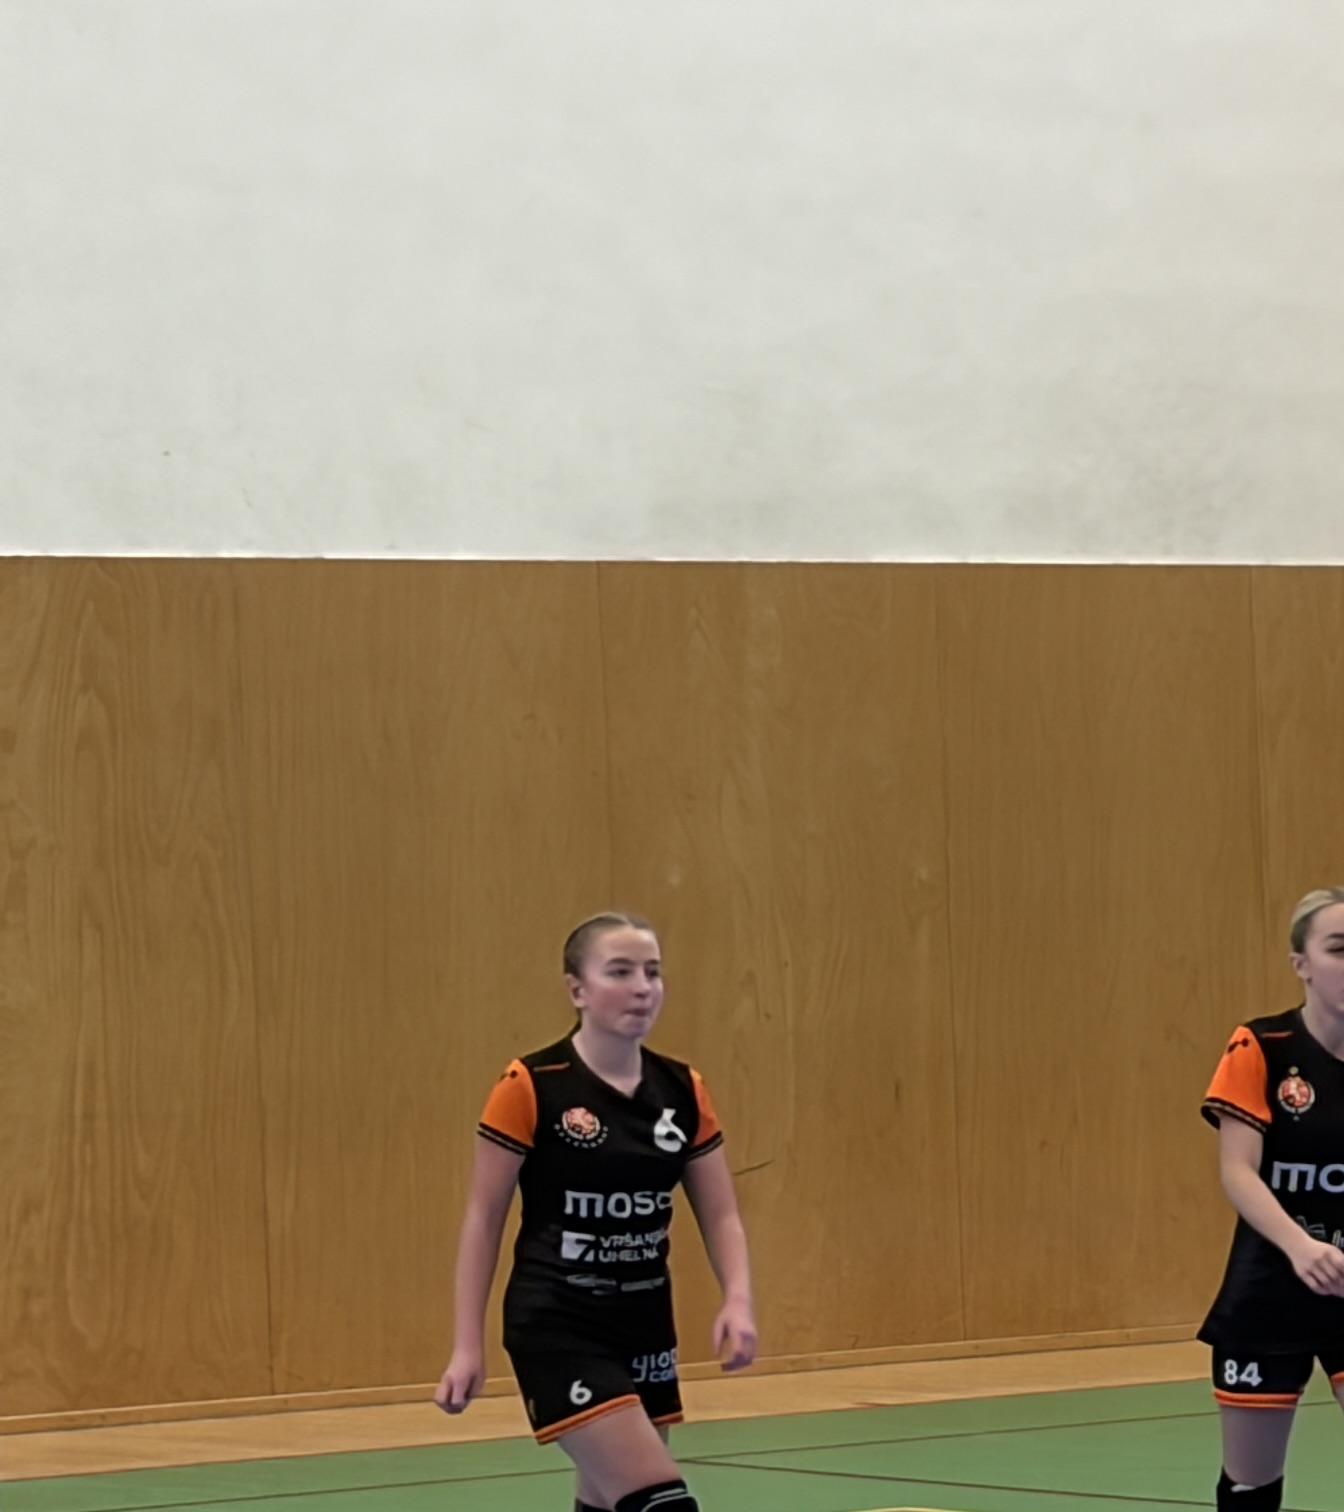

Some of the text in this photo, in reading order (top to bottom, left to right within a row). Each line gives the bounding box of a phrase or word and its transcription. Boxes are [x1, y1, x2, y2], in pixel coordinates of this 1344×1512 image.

[653, 1108, 688, 1152] 6
[1224, 1359, 1263, 1386] 84
[569, 1379, 593, 1406] 6
